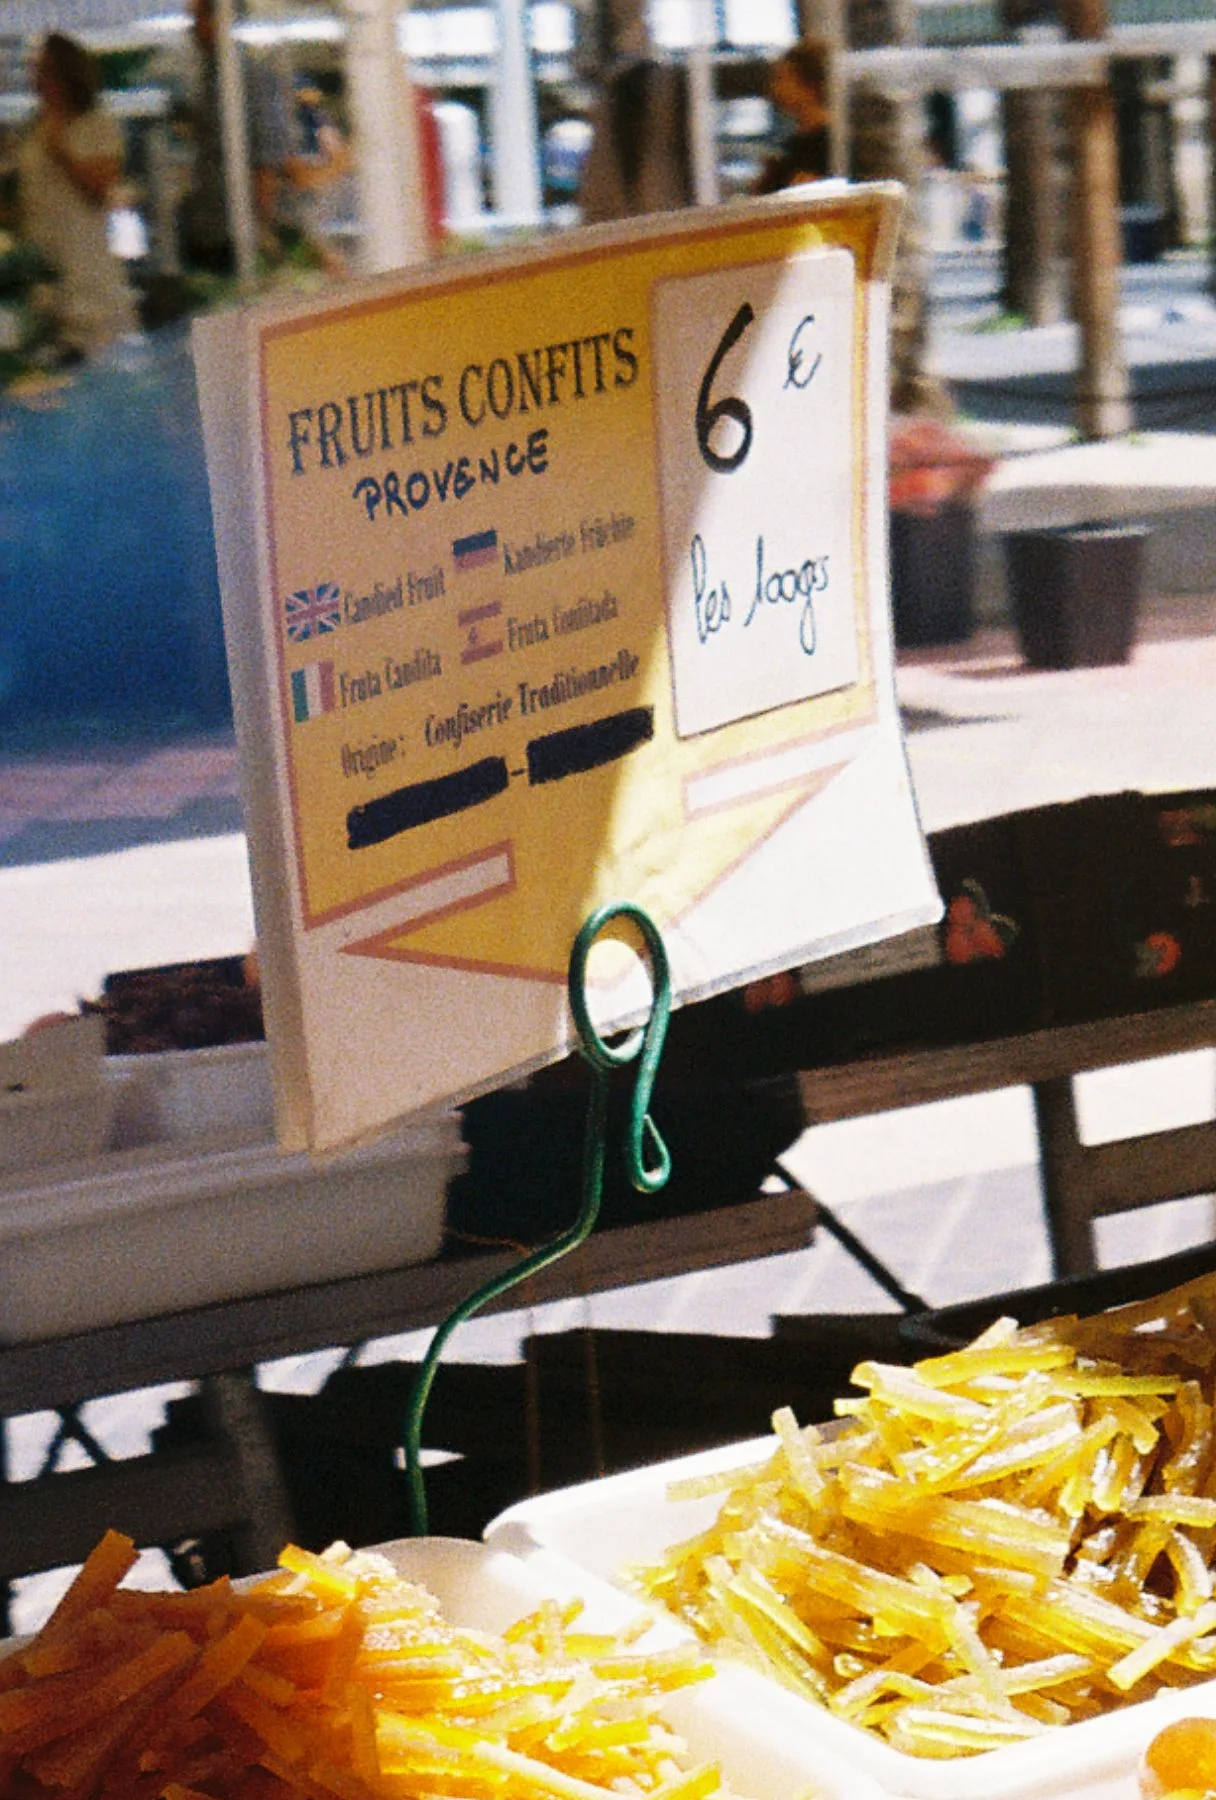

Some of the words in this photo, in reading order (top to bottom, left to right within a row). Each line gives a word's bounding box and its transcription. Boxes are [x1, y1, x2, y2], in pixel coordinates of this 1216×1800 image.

[287, 374, 449, 476] FRUITS
[458, 327, 640, 430] CONFITS
[694, 302, 754, 474] 6
[783, 314, 823, 390] €
[352, 428, 550, 521] PROVENCE
[343, 578, 403, 626] Candied
[407, 564, 446, 607] Fruit
[424, 689, 514, 750] Confiserie
[516, 647, 641, 718] Traditionnelle
